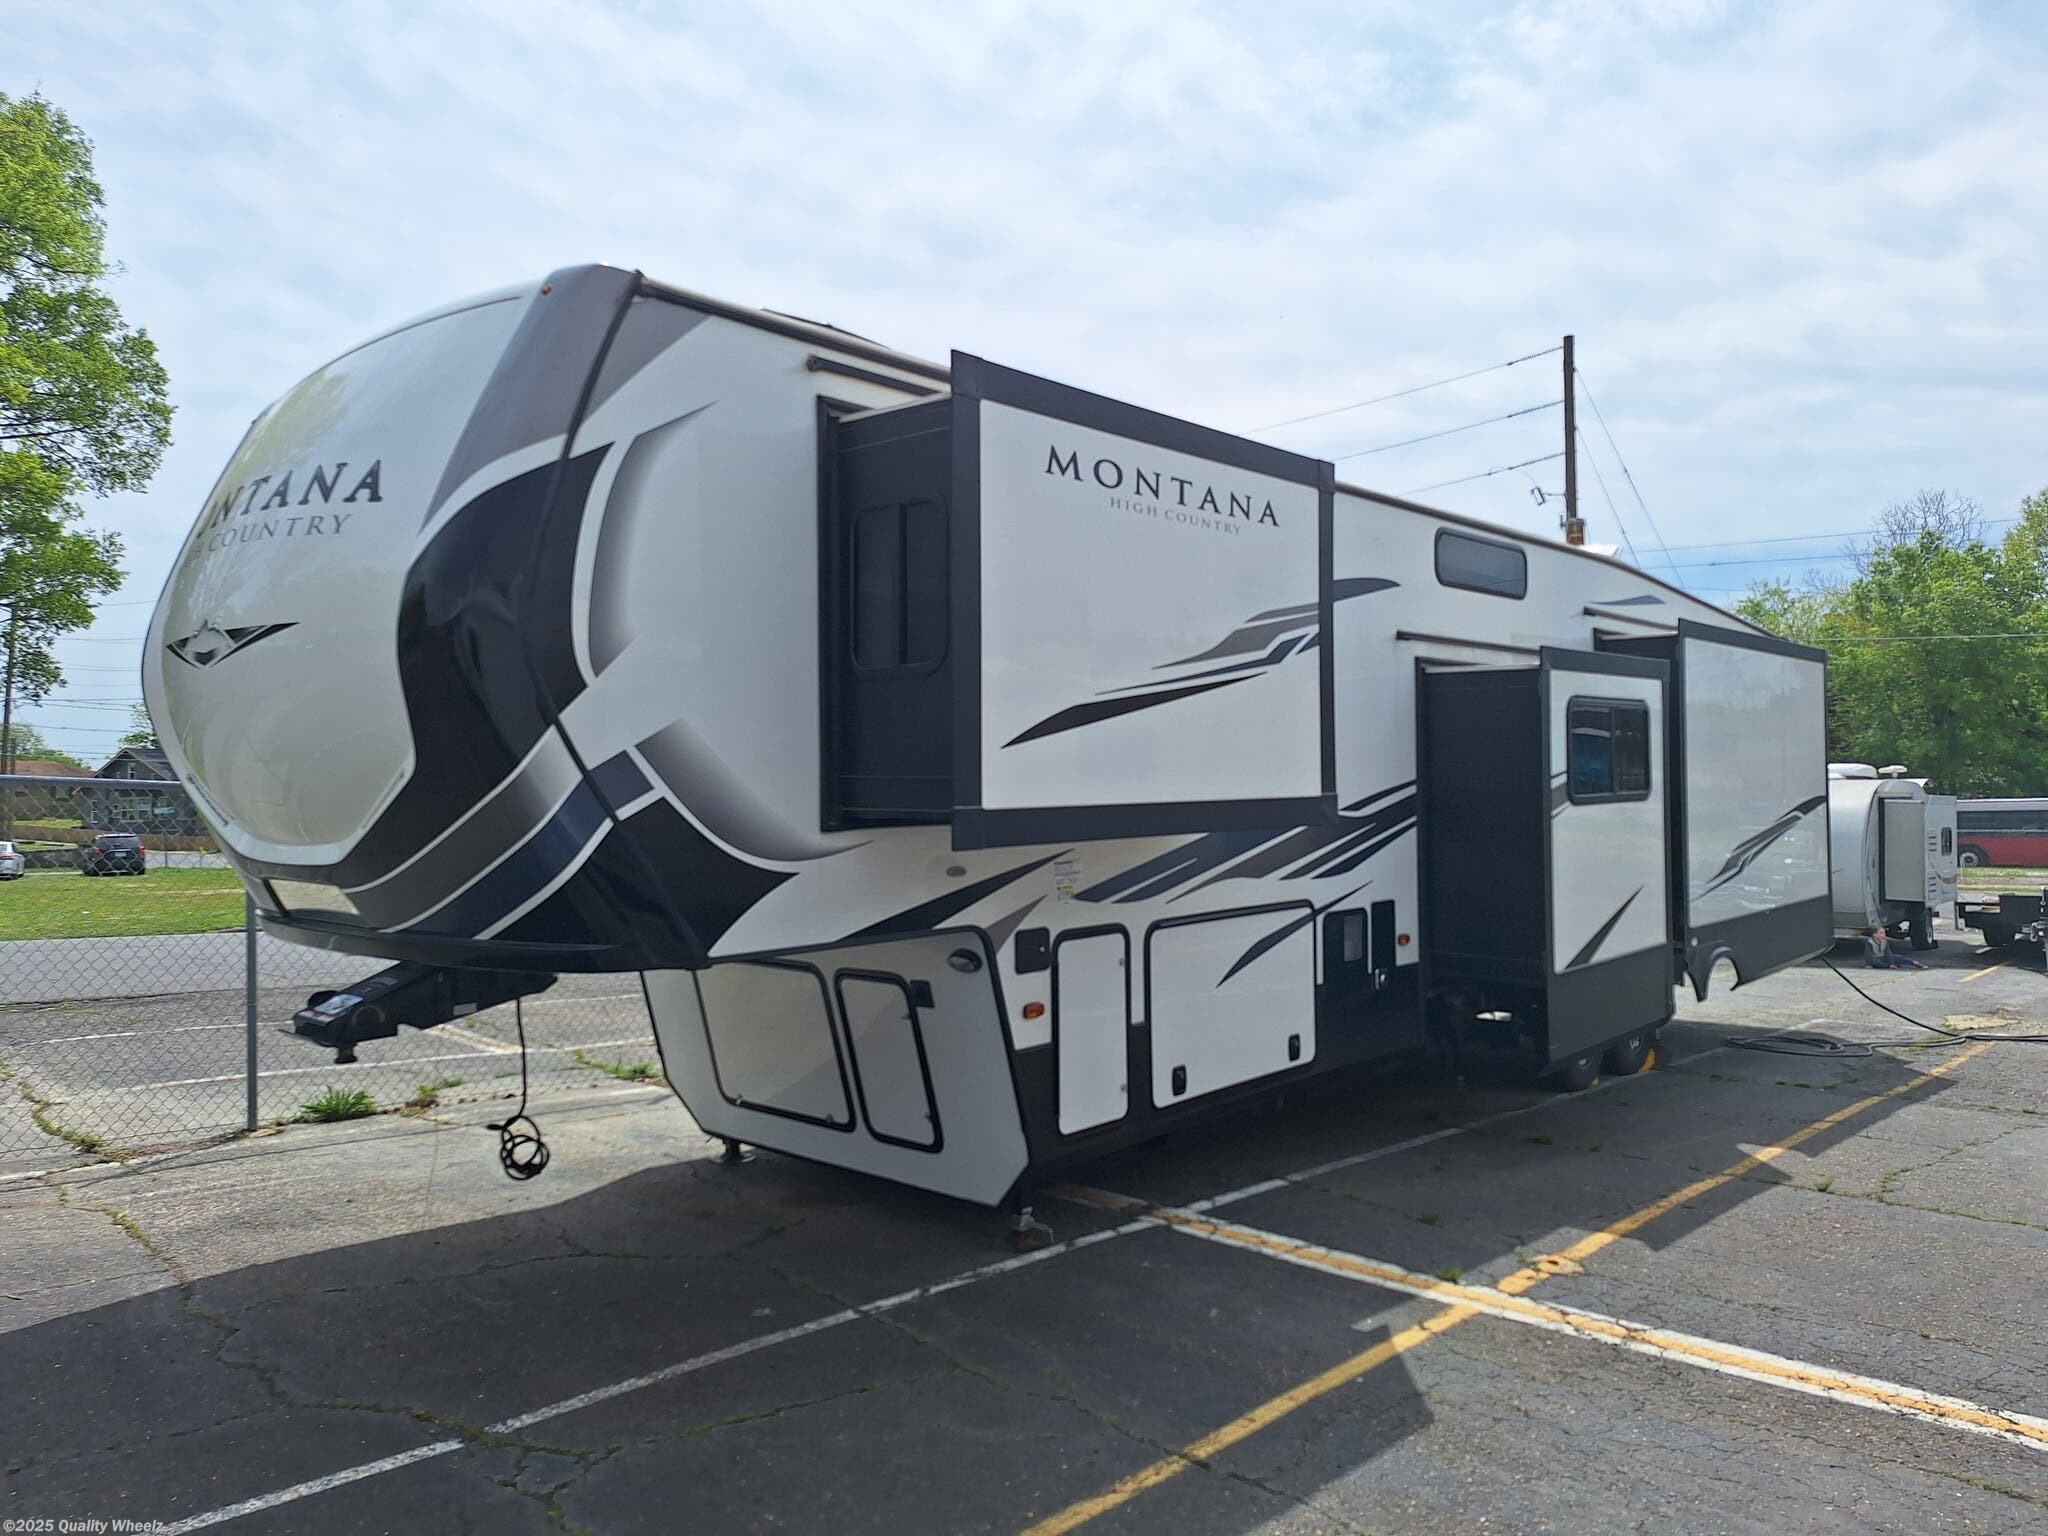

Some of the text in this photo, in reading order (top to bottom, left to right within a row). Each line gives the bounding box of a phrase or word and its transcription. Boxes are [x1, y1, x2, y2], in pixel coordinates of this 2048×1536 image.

[1044, 444, 1280, 528] MONTANA
[208, 513, 352, 553] COUNTRY
[1110, 497, 1241, 536] HIGH COUNTRY
